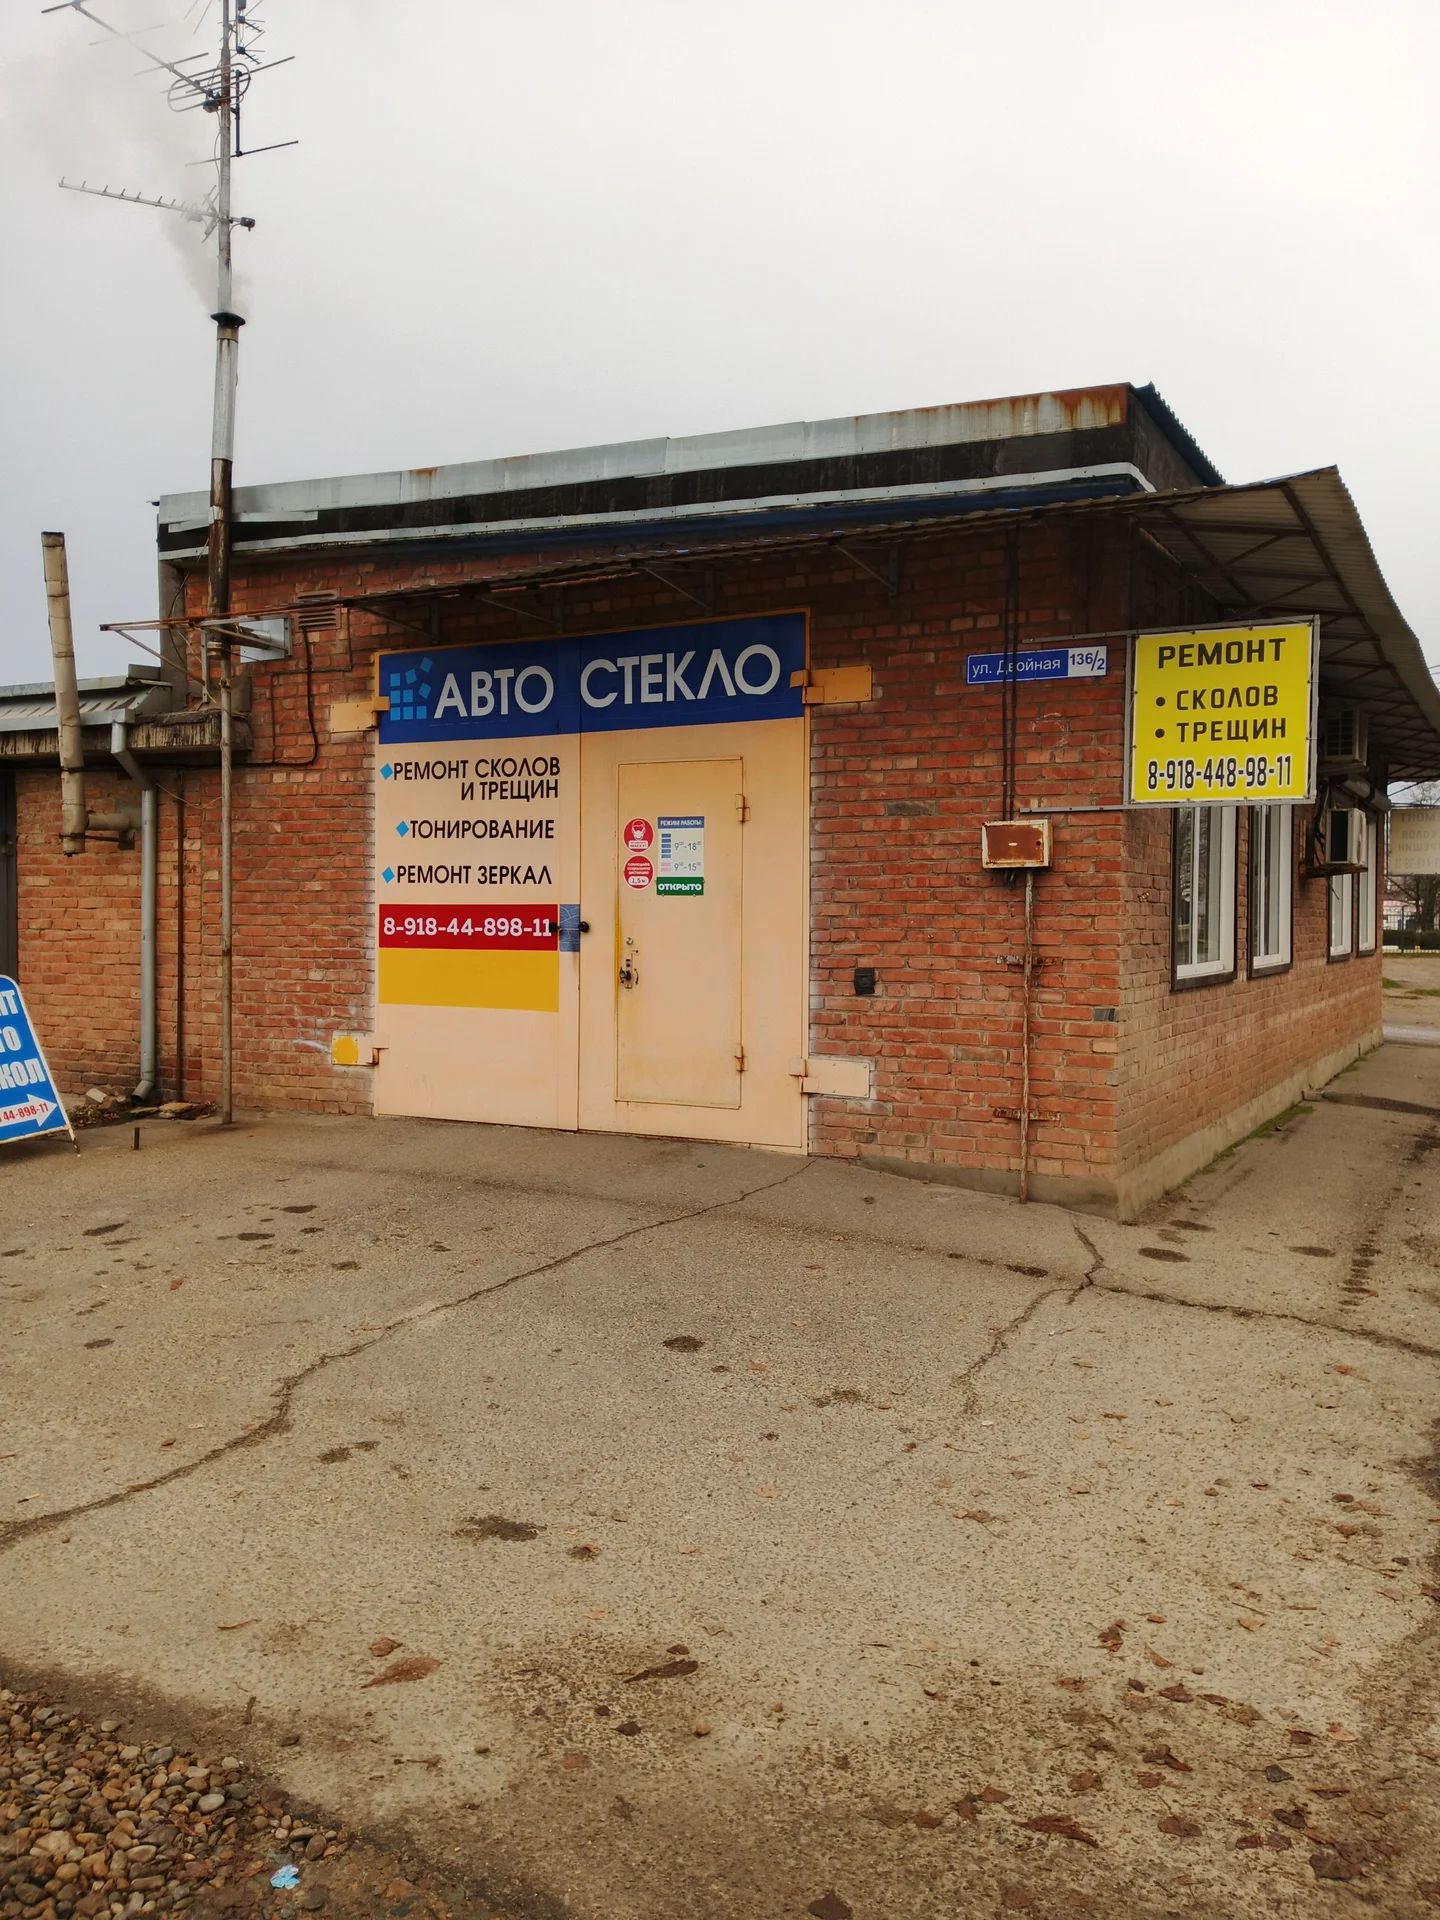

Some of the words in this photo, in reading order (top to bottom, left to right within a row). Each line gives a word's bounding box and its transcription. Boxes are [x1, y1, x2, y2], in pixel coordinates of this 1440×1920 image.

[973, 664, 992, 678] ул.
[997, 658, 1061, 675] Двойная
[1069, 649, 1105, 671] 136/2
[1158, 638, 1286, 669] РЕМОНТ
[434, 665, 554, 719] АВТО
[580, 644, 781, 708] СТЕКЛО
[1176, 685, 1279, 710] СКОЛОВ
[1176, 718, 1287, 743] ТРЕЩИН
[393, 760, 469, 781] РЕМОНТ
[475, 757, 560, 778] СКОЛОВ
[1147, 755, 1293, 790] 8-918-448-98-11
[461, 782, 474, 800] И
[479, 779, 558, 802] ТРЕЩИН
[410, 820, 554, 839] ТОНИРОВАНИЕ
[397, 865, 471, 884] РЕМОНТ
[477, 865, 552, 885] ЗЕРКАЛ
[658, 883, 702, 891] ОТКРЫТО
[383, 917, 552, 937] 8-918-44-898-11
[0, 1058, 46, 1090] КОЛ
